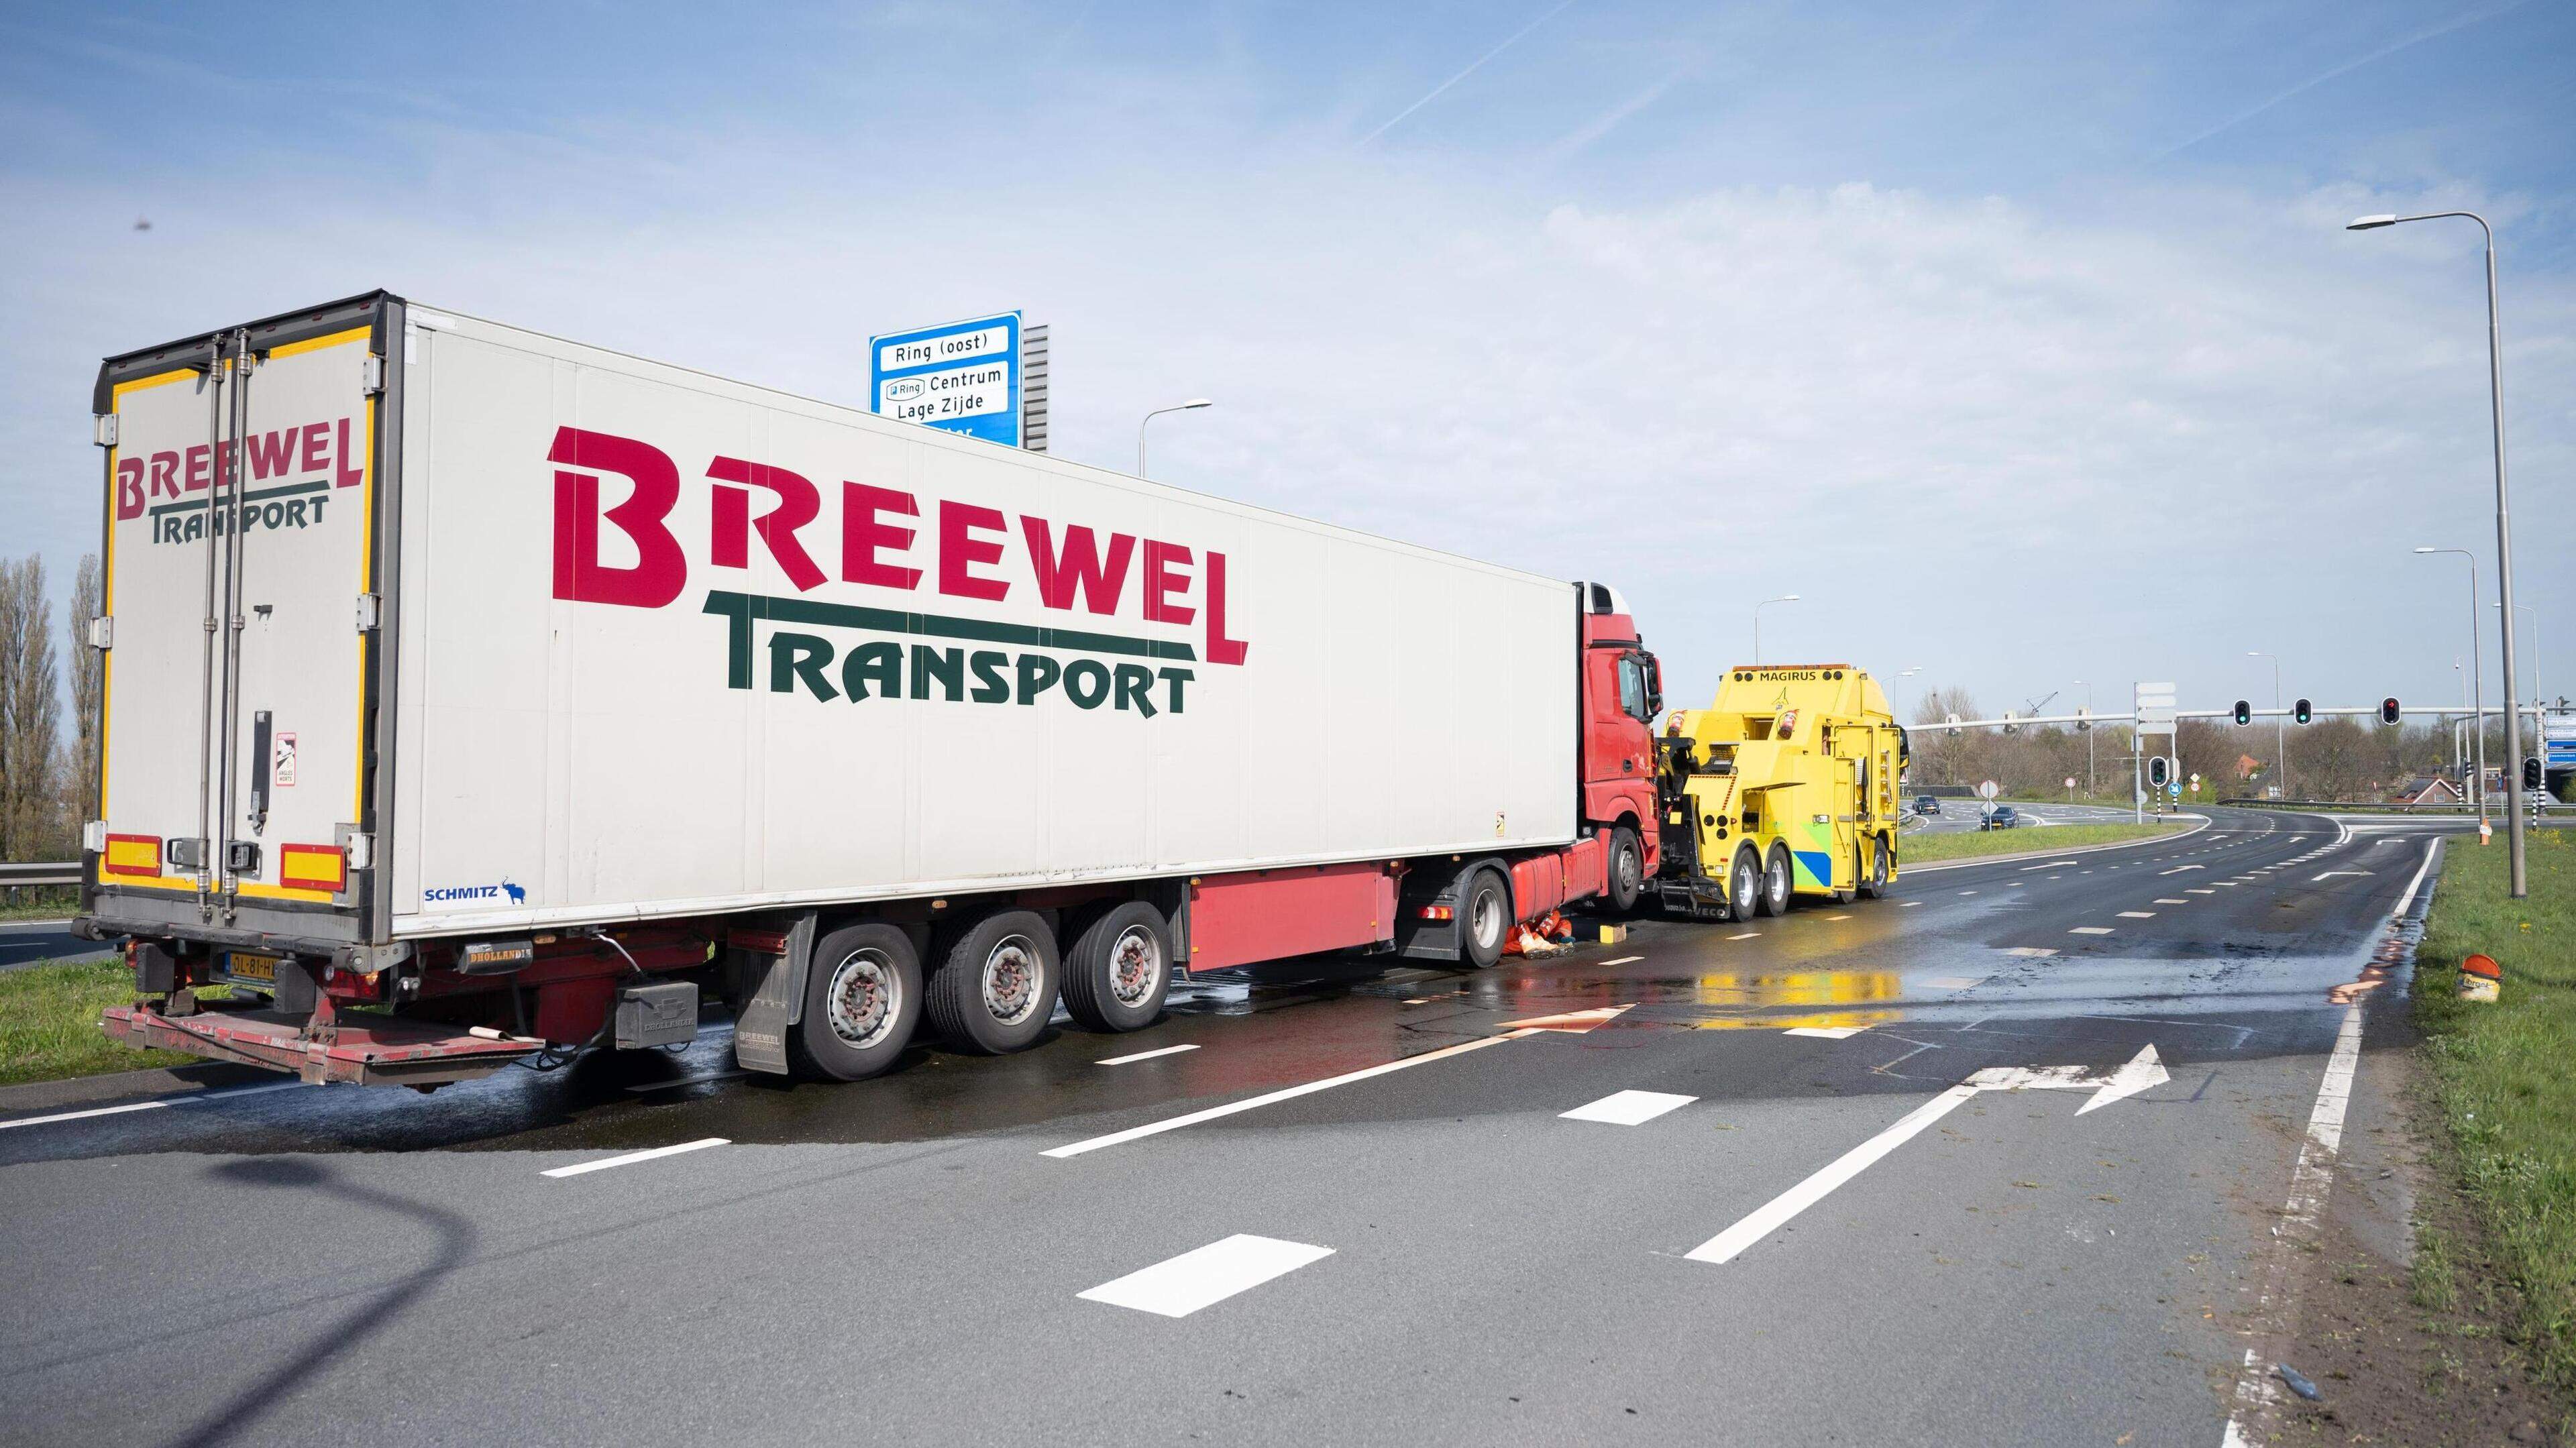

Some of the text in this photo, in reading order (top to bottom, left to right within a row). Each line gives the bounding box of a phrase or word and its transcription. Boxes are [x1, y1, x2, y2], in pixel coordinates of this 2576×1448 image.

[896, 333, 987, 362] Ring (oost)
[900, 384, 920, 394] Ring
[930, 370, 1001, 391] Centrum
[898, 394, 983, 421] Lage Zijde
[117, 417, 364, 520] BREEWEL
[148, 480, 330, 545] TRANPORT
[547, 426, 1248, 665] BREEWEL
[702, 590, 1197, 719] TRANSPORT
[1760, 671, 1816, 681] MAGIRUS
[425, 885, 498, 901] SCHMITZ
